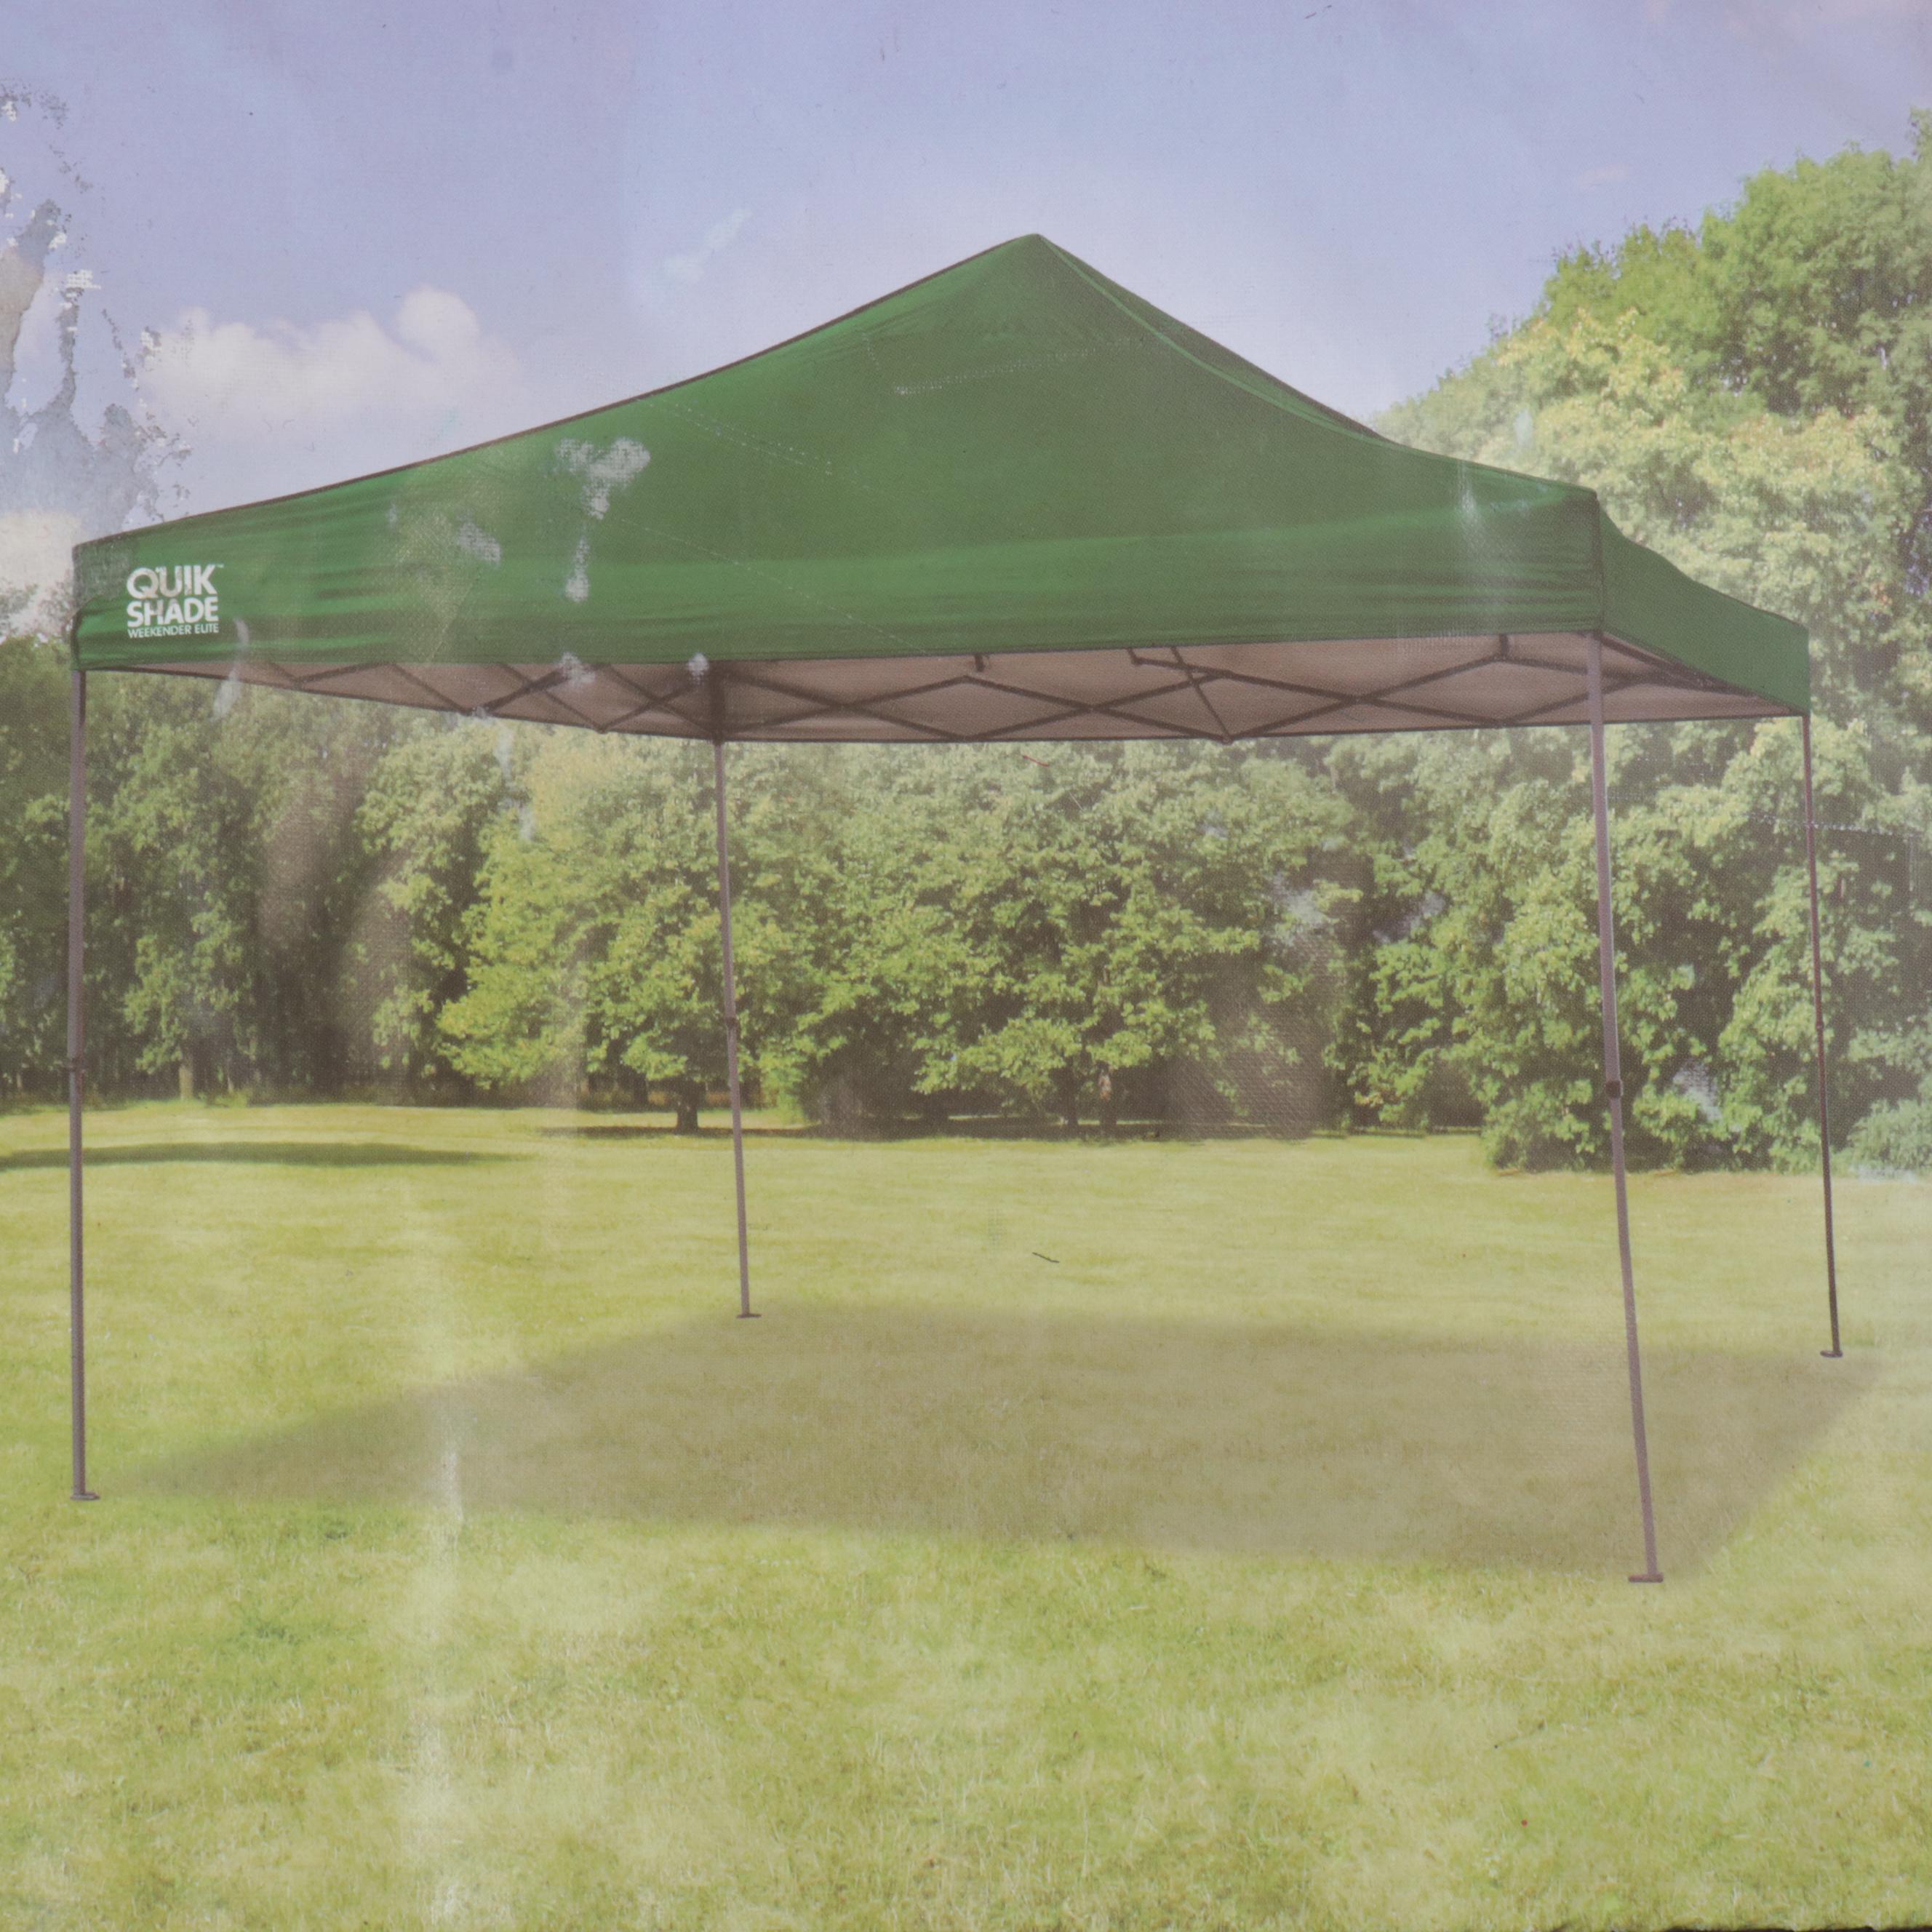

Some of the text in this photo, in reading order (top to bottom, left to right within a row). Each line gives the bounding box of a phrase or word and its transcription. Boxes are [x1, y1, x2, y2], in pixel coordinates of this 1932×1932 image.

[127, 564, 217, 599] QUIK
[127, 596, 218, 628] SHADE
[127, 623, 219, 639] WEEKENDER ELITE
